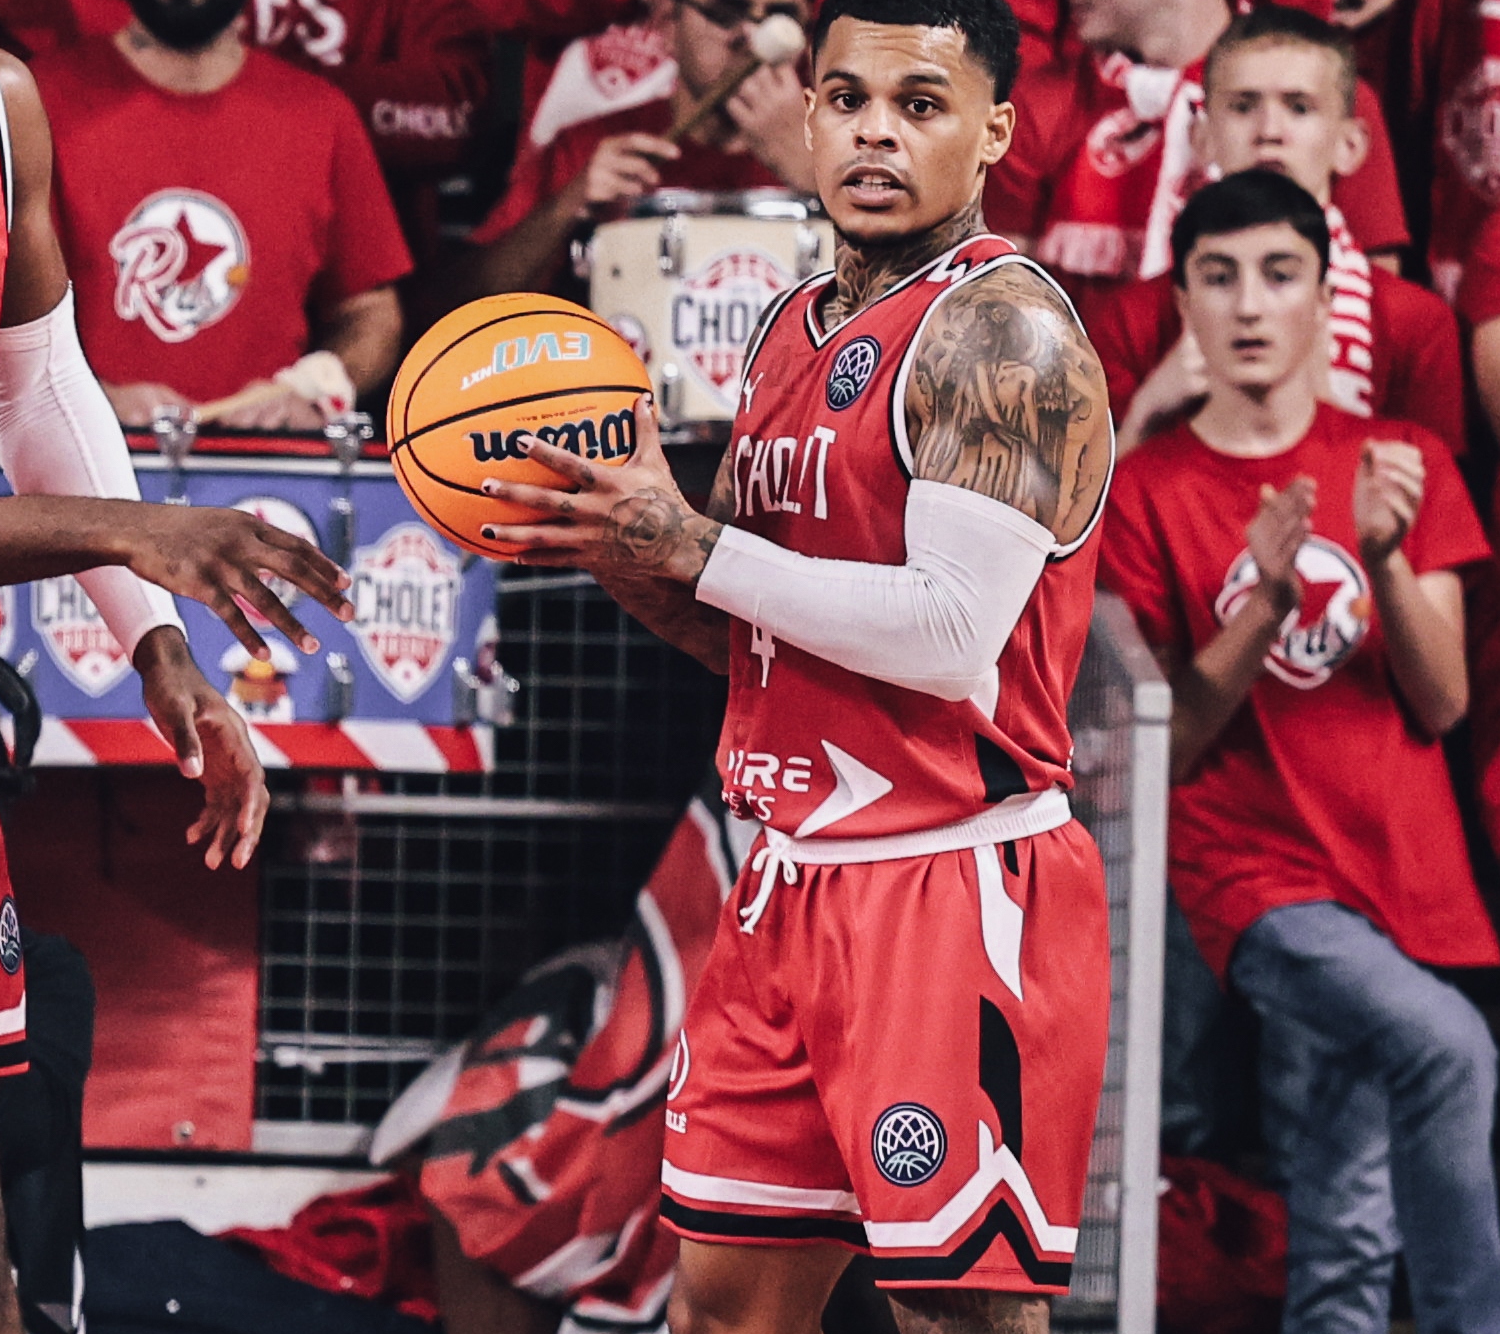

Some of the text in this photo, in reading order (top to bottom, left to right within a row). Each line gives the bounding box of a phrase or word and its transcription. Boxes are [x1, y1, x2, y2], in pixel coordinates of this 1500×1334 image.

[671, 294, 762, 349] CHO
[468, 408, 637, 464] Wilson
[354, 569, 459, 630] CHOLET
